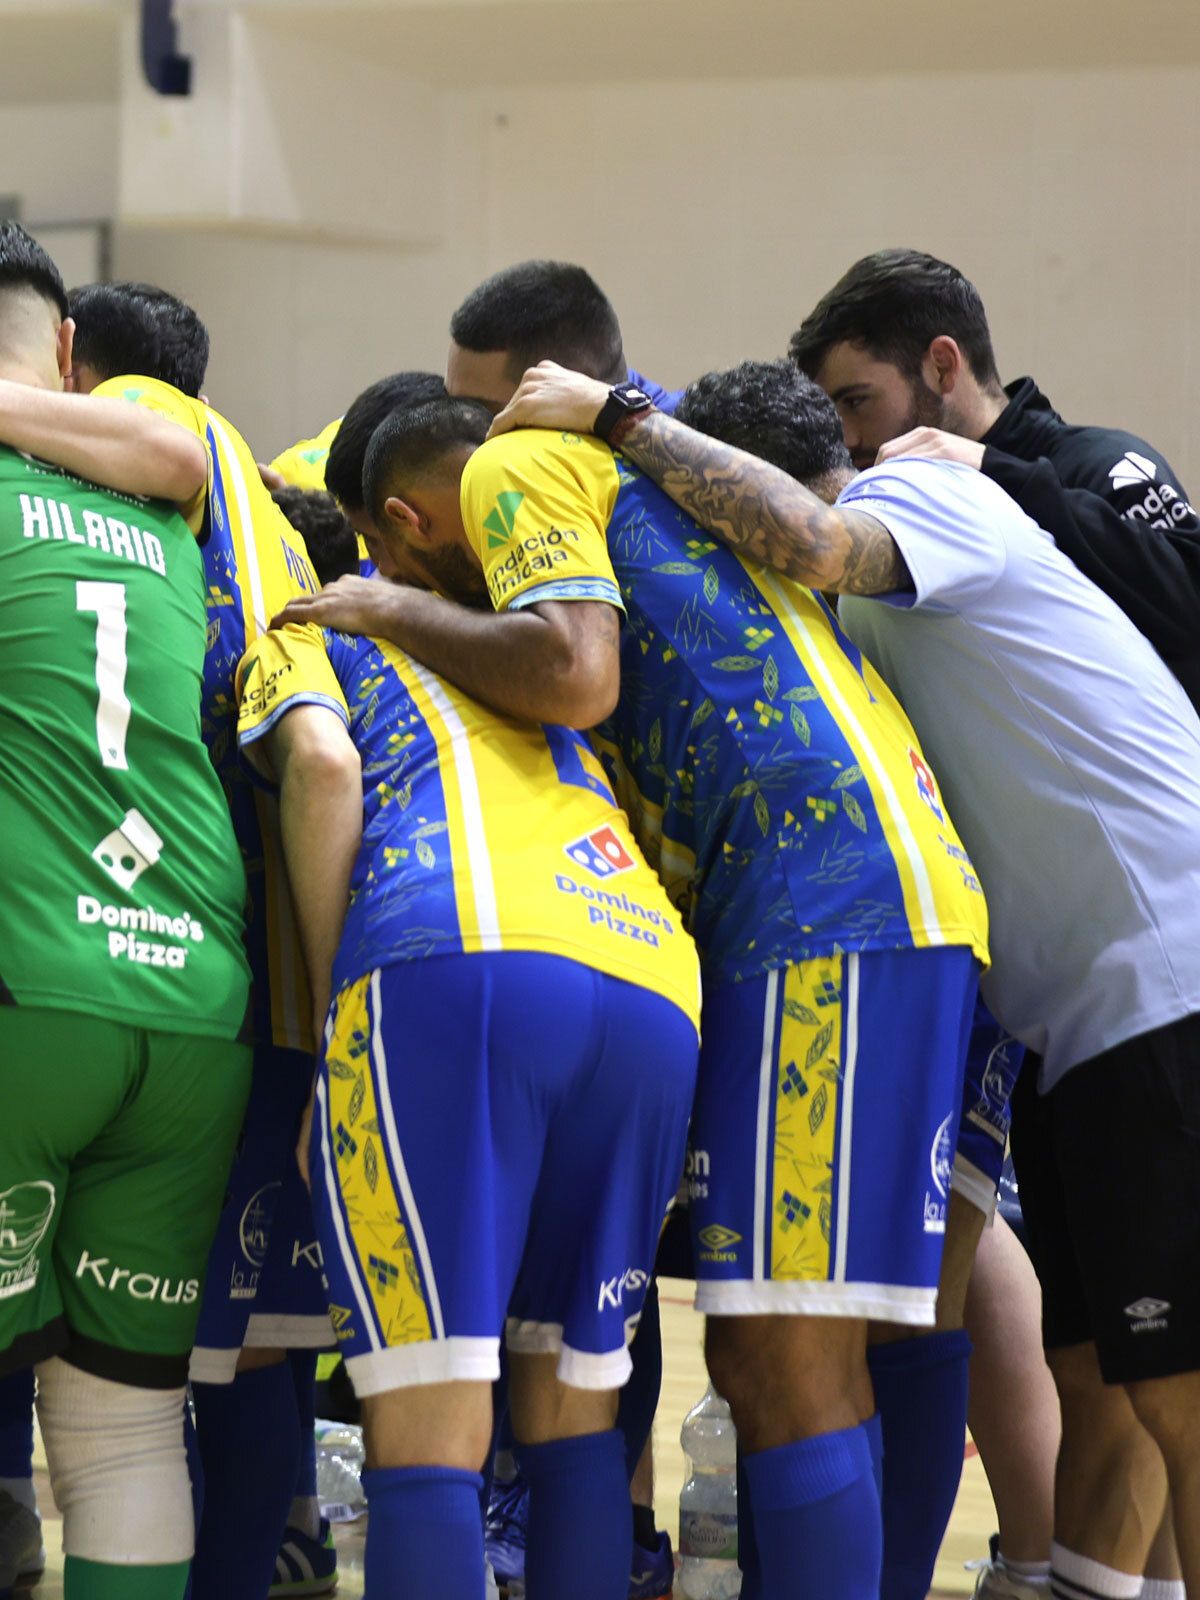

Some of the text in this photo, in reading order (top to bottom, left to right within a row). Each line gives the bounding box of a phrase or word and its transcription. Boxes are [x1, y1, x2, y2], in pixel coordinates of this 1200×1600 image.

[19, 493, 167, 577] HILARIO
[76, 581, 132, 771] 1
[241, 662, 293, 704] ación
[238, 684, 278, 718] caja
[77, 894, 205, 942] Domino's
[587, 904, 660, 949] Pizza
[108, 930, 186, 969] Pizza
[75, 1250, 200, 1304] Kraus
